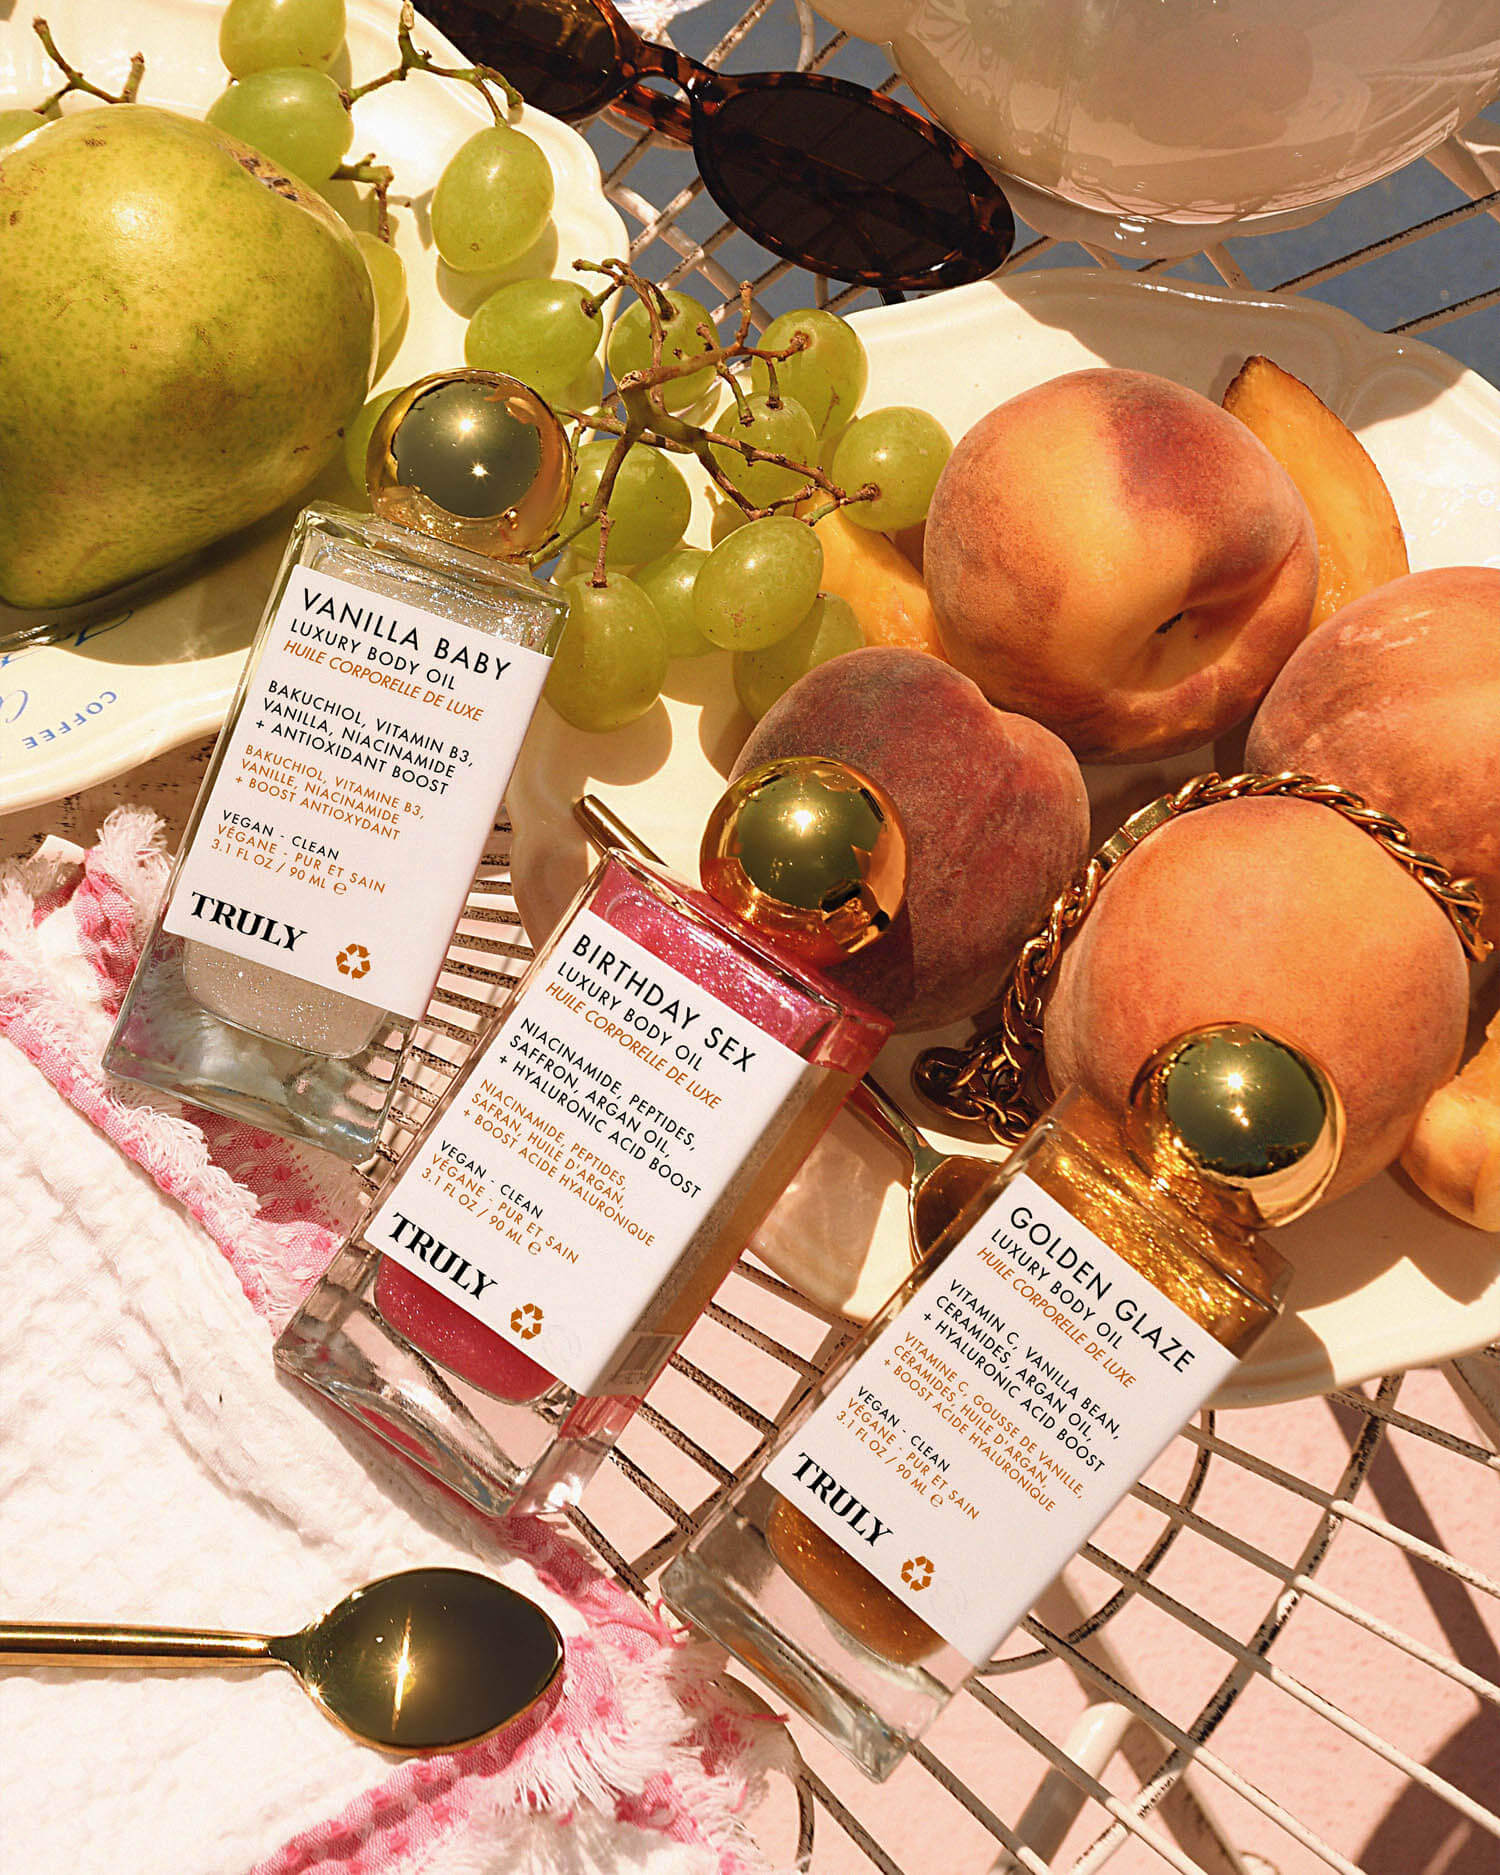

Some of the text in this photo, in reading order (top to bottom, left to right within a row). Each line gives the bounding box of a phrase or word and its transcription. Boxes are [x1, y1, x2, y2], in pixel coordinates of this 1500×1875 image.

[291, 618, 454, 690] LUXURY BODY OIL
[305, 588, 511, 680] VANILLA BABY
[22, 690, 118, 750] COFFEE
[268, 680, 472, 767] BAKUCHIOL, VITAMIN B3,
[283, 640, 484, 721] HUILE CORPORELLE DE LUXE
[246, 744, 423, 819] BAKUCHIOL, VITAMINE B3,
[256, 720, 448, 794] + ANTIOXIDANT BOOST
[265, 697, 455, 778] VANILLA, NIACINAMIDE
[224, 810, 273, 837] VEGAN
[292, 836, 339, 860] CLEAN
[243, 758, 400, 824] VANILLE, NIACINAMIDE
[249, 778, 296, 802] BOOST
[300, 797, 400, 840] ANTIOXYDANT
[211, 838, 231, 854] 3.1
[236, 848, 248, 861] FL
[254, 854, 273, 869] OZ
[275, 862, 286, 872] /
[290, 867, 305, 880] 90
[309, 874, 325, 888] ML
[219, 824, 277, 854] VÉGANE
[295, 852, 321, 870] PUR
[328, 864, 344, 877] ET
[350, 872, 386, 894] SAIN
[191, 891, 308, 951] TRULY
[545, 982, 722, 1109] HUILE CORPORELLE DE LUXE
[558, 962, 702, 1071] LUXURY BODY OIL
[572, 934, 756, 1072] BIRTHDAY SEX
[472, 1093, 521, 1136] SAFRAN,
[528, 1132, 563, 1162] HUILE
[500, 1056, 701, 1198] + HYALURONIC ACID BOOST
[510, 1035, 669, 1158] SAFFRON, ARGAN OIL,
[520, 1018, 695, 1151] NIACINAMIDE, PEPTIDES,
[441, 1140, 486, 1178] VEGAN
[501, 1184, 543, 1219] CLEAN
[474, 1114, 518, 1148] BOOST
[518, 1147, 558, 1178] ACIDE
[559, 1174, 655, 1246] HYALURONIQUE
[480, 1079, 625, 1190] NIACINAMIDE, PEPTIDES,
[422, 1168, 440, 1186] 3.1
[443, 1183, 456, 1198] FL
[459, 1194, 477, 1212] OZ
[476, 1209, 488, 1217] /
[489, 1216, 504, 1231] 90
[505, 1227, 522, 1245] ML
[433, 1153, 485, 1197] VÉGANE
[498, 1202, 523, 1225] PUR
[526, 1222, 543, 1237] ET
[545, 1236, 579, 1264] SAIN
[388, 1212, 498, 1300] TRULY
[991, 1229, 1122, 1349] LUXURY BODY OIL
[1011, 1207, 1195, 1373] GOLDEN GLAZE
[950, 1279, 1120, 1439] VITAMIN C, VANILLA BEAN,
[976, 1248, 1136, 1388] HUILE CORPORELLE DE LUXE
[894, 1345, 956, 1407] CÉRAMIDES,
[960, 1404, 993, 1435] HUILE
[935, 1320, 1020, 1398] HYALURONIC
[1020, 1399, 1055, 1429] ACID
[1057, 1428, 1105, 1471] BOOST
[937, 1296, 1091, 1442] CERAMIDES, ARGAN OIL,
[837, 1411, 855, 1429] 3.1
[856, 1427, 868, 1442] FL
[869, 1440, 888, 1458] OZ
[896, 1464, 911, 1479] 90
[910, 1478, 927, 1495] ML
[848, 1397, 896, 1445] VÉGANE
[906, 1452, 930, 1476] PUR
[931, 1474, 948, 1490] ET
[948, 1490, 979, 1520] SAIN
[858, 1386, 900, 1428] VEGAN
[911, 1436, 950, 1472] CLEAN
[893, 1365, 933, 1401] BOOST
[932, 1402, 968, 1434] ACIDE
[969, 1432, 1056, 1512] HYALURONIQUE
[905, 1332, 1083, 1499] VITAMINE C, GOUSSE DE VANILLE,
[792, 1452, 893, 1547] TRULY
